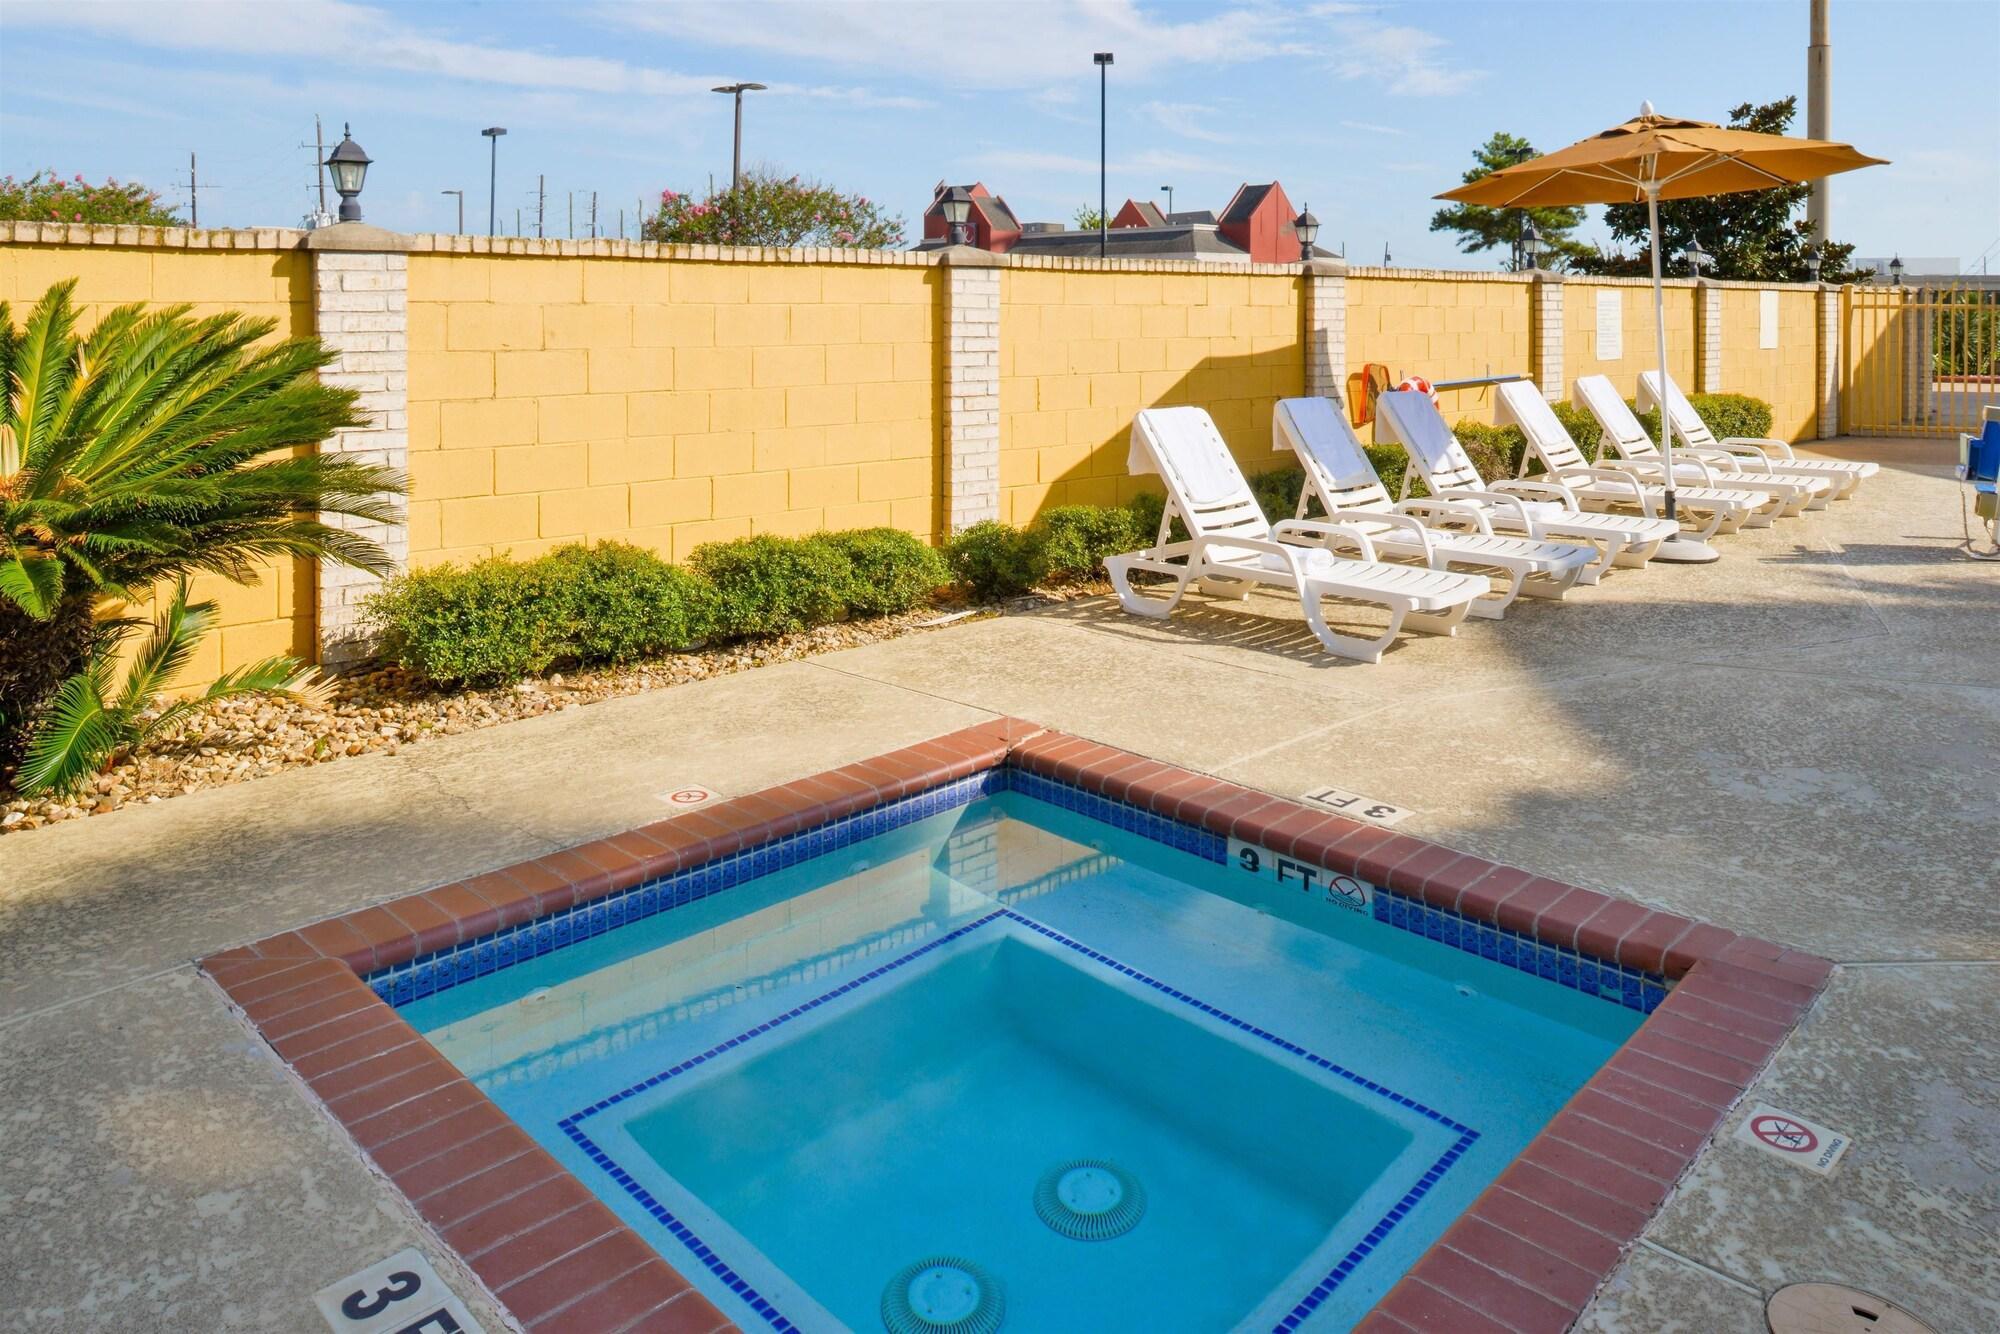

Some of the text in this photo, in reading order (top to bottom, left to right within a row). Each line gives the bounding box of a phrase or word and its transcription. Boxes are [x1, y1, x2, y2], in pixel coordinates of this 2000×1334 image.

[1306, 790, 1397, 818] 3 FT
[1239, 848, 1317, 892] 3 FT
[1325, 896, 1338, 905] NO
[1815, 1138, 1843, 1169] NO DIVING
[341, 1271, 465, 1334] 3 F
